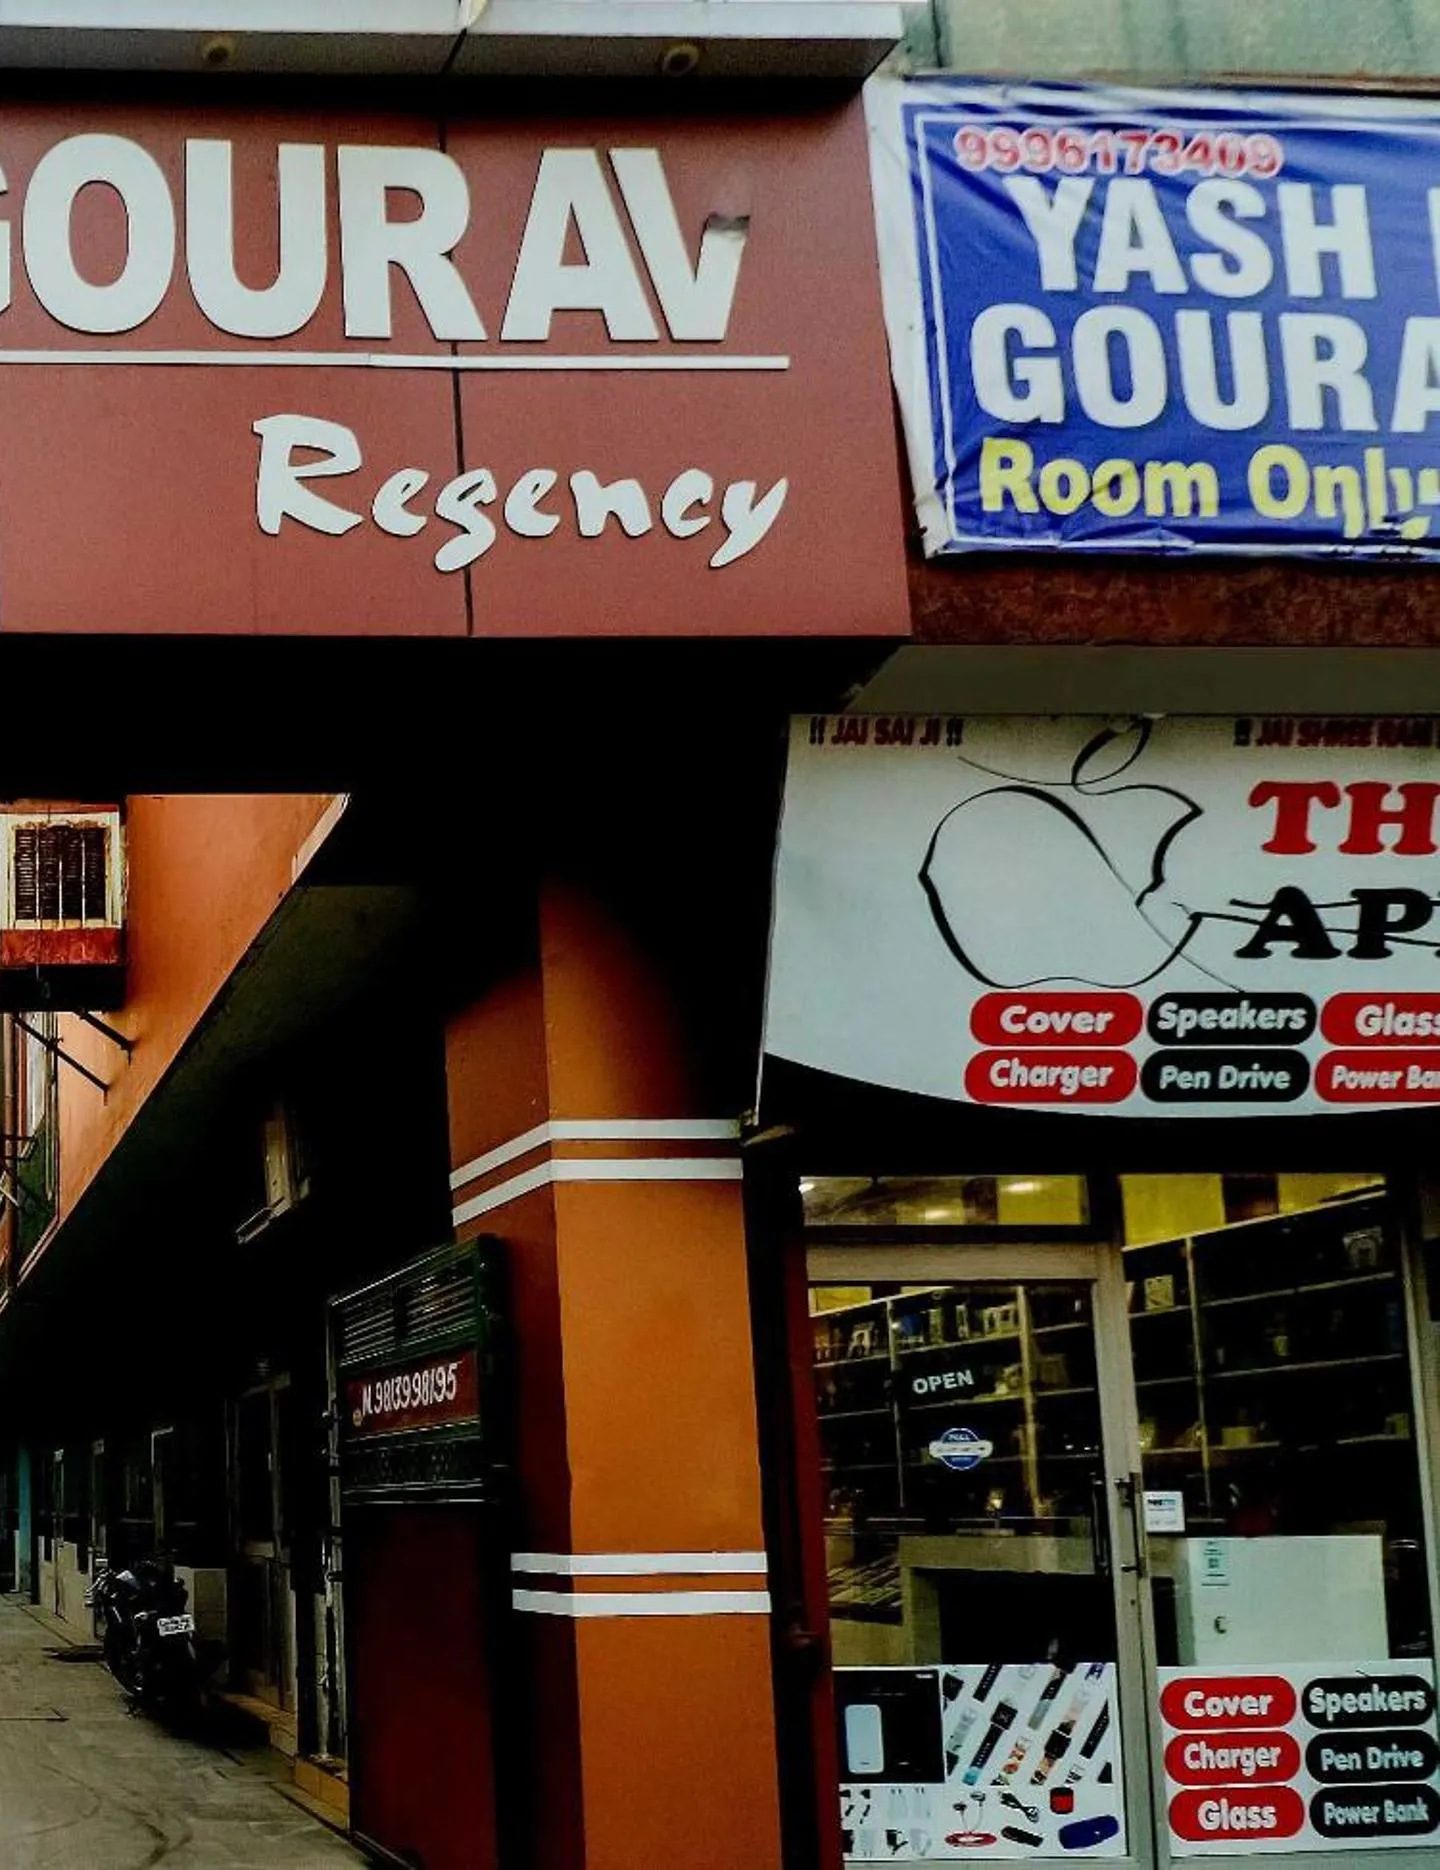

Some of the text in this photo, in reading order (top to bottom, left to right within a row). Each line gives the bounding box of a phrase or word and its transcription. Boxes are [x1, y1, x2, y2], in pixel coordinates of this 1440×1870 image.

[1002, 176, 1378, 299] YASH
[971, 303, 1440, 432] GOURA
[253, 413, 788, 572] Regency
[979, 437, 1219, 518] Room
[831, 717, 868, 745] JAI
[874, 717, 915, 745] SAI
[920, 717, 941, 745] JI
[1234, 885, 1440, 961] AP
[1000, 1004, 1115, 1034] Cover
[1157, 1000, 1308, 1038] Speakers
[989, 1057, 1114, 1096] Charger
[1159, 1063, 1291, 1090] Pen Drive
[1331, 1065, 1403, 1090] Power
[912, 1369, 975, 1394] OPEN
[1184, 1691, 1274, 1718] Cover
[1309, 1683, 1428, 1723] Speakers
[1183, 1740, 1282, 1777] Charger
[1320, 1743, 1425, 1772] Pen Drive
[1197, 1798, 1278, 1831] Glass
[1324, 1796, 1430, 1826] Power Bank
